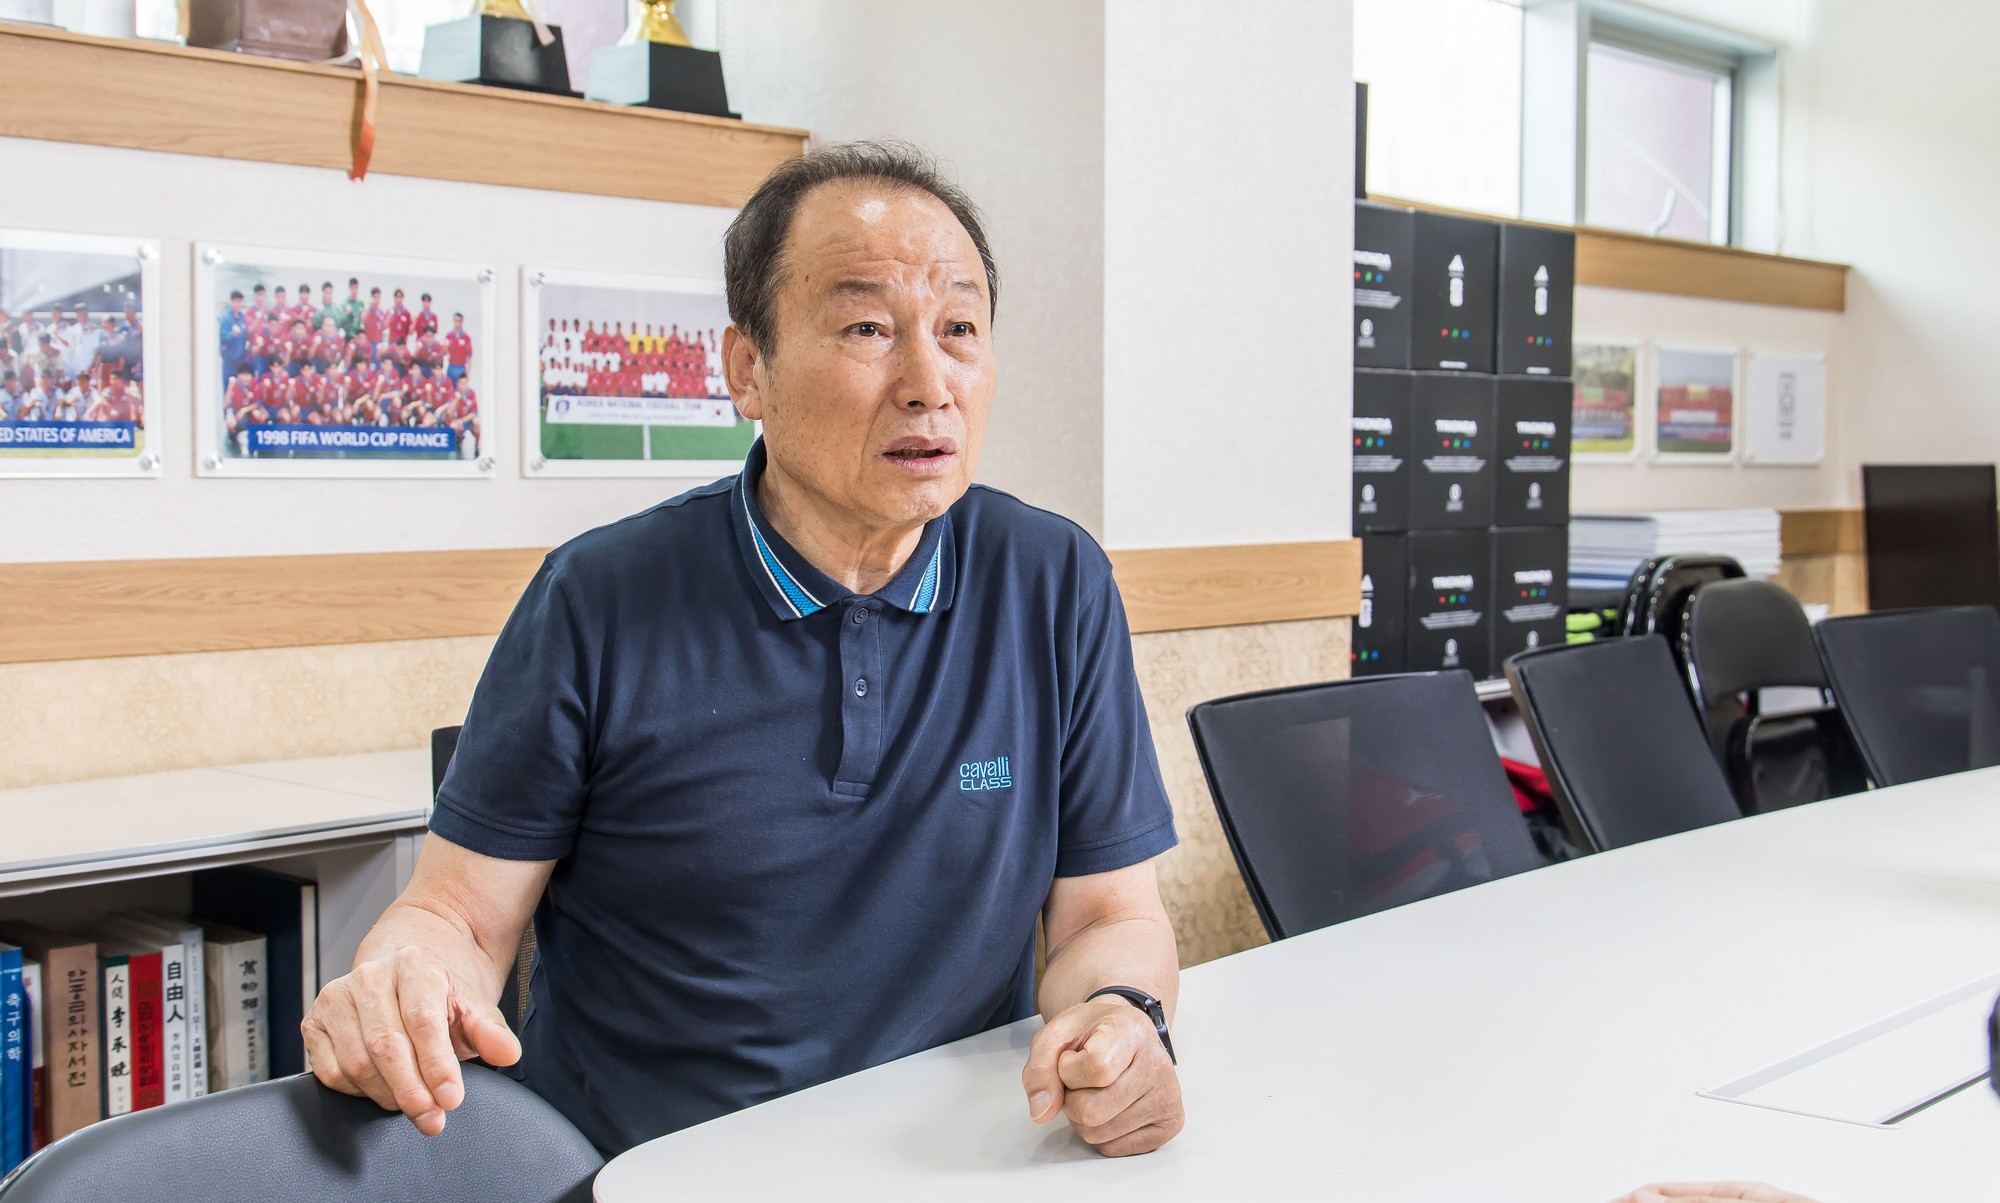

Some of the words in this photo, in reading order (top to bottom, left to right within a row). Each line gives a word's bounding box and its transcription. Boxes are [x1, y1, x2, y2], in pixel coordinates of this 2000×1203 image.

[15, 427, 59, 443] STATES
[59, 427, 76, 443] OF
[77, 428, 131, 443] AMERICA
[256, 430, 289, 446] 1998
[291, 431, 318, 446] FIFA
[319, 431, 370, 447] WORLD
[371, 432, 398, 447] CUP
[400, 432, 449, 448] FRANCE
[960, 756, 1010, 778] cavalli
[960, 776, 1012, 791] CLASS
[166, 960, 185, 1023] 自由人
